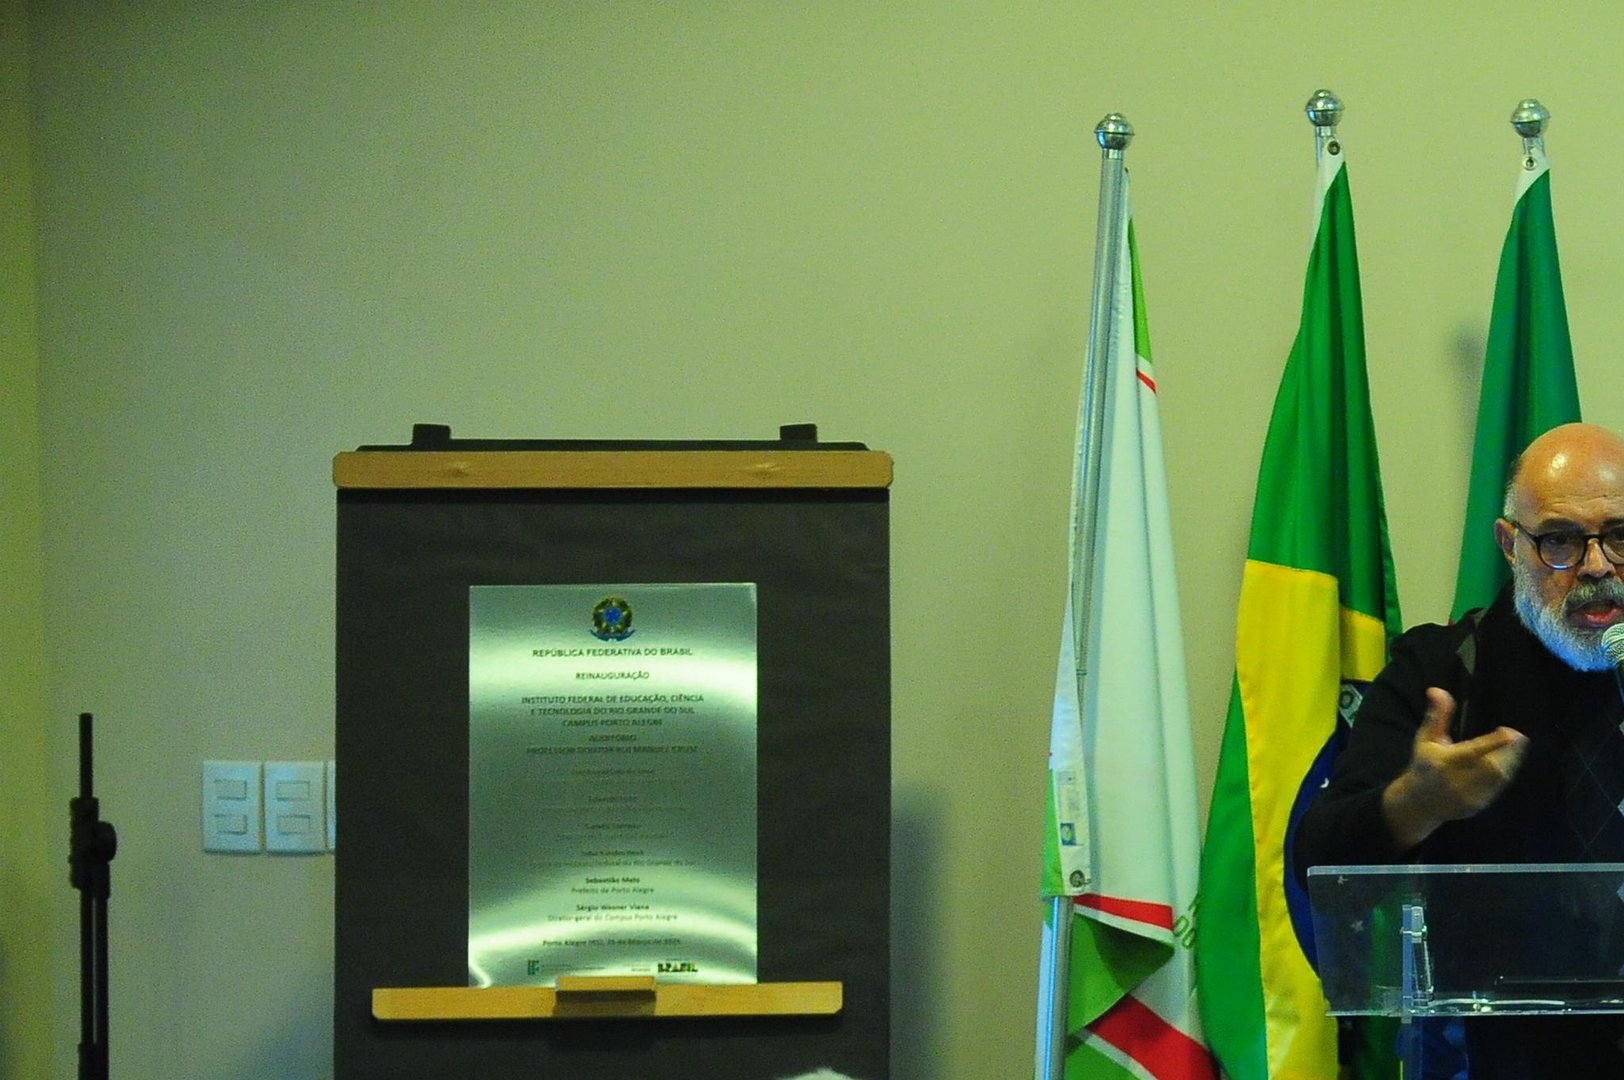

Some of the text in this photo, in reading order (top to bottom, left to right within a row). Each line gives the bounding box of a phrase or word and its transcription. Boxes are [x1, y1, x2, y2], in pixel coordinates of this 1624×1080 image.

[532, 647, 693, 657] REPÚBLICA FEDERATIVA DO BRASIL
[575, 670, 650, 680] REINAUGURAÇÃO
[521, 696, 565, 704] INSTITUTO
[567, 695, 604, 704] FEDERAL
[606, 695, 617, 703] DE
